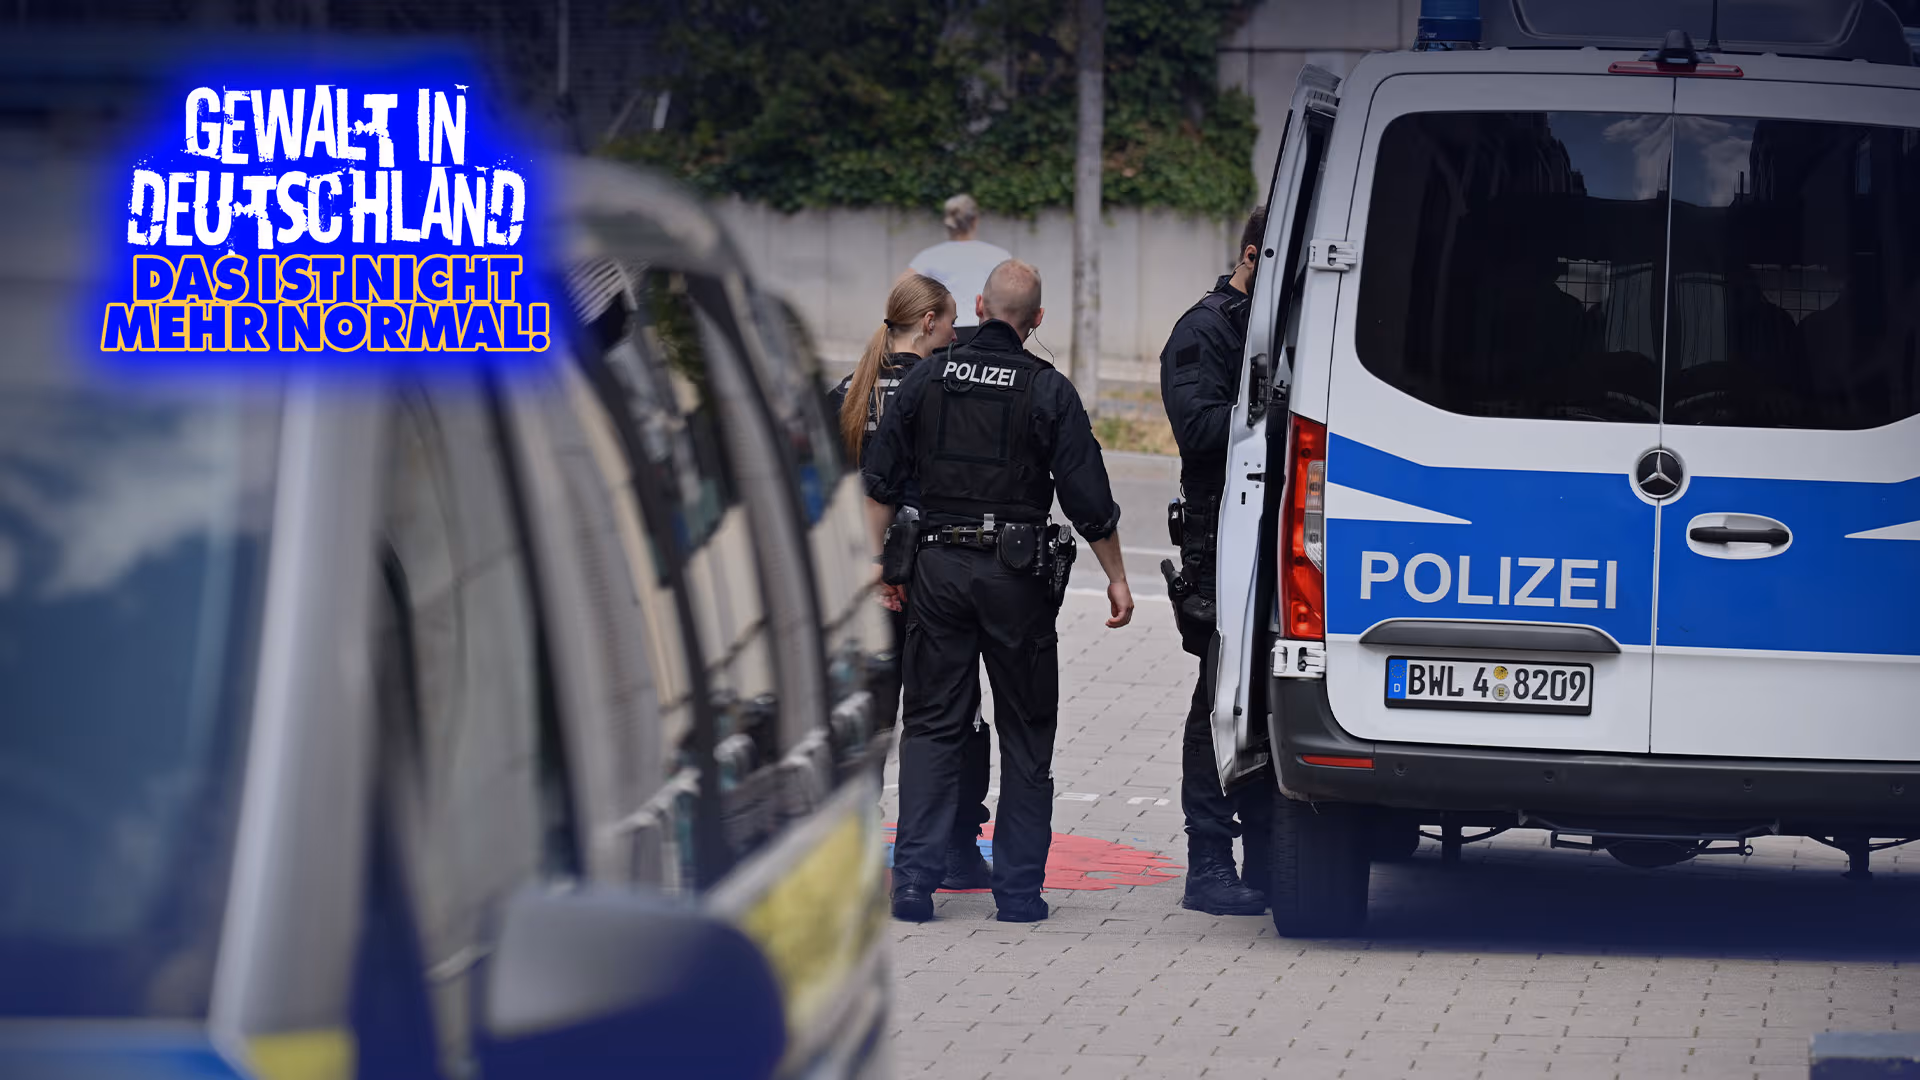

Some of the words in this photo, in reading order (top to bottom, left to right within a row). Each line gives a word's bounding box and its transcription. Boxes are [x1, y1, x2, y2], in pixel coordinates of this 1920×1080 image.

[942, 361, 1016, 386] POLIZEI
[1360, 551, 1617, 608] POLIZEI
[1394, 683, 1401, 693] D
[1408, 664, 1464, 697] BWL
[1473, 667, 1489, 698] 4
[1513, 668, 1586, 702] 8209
